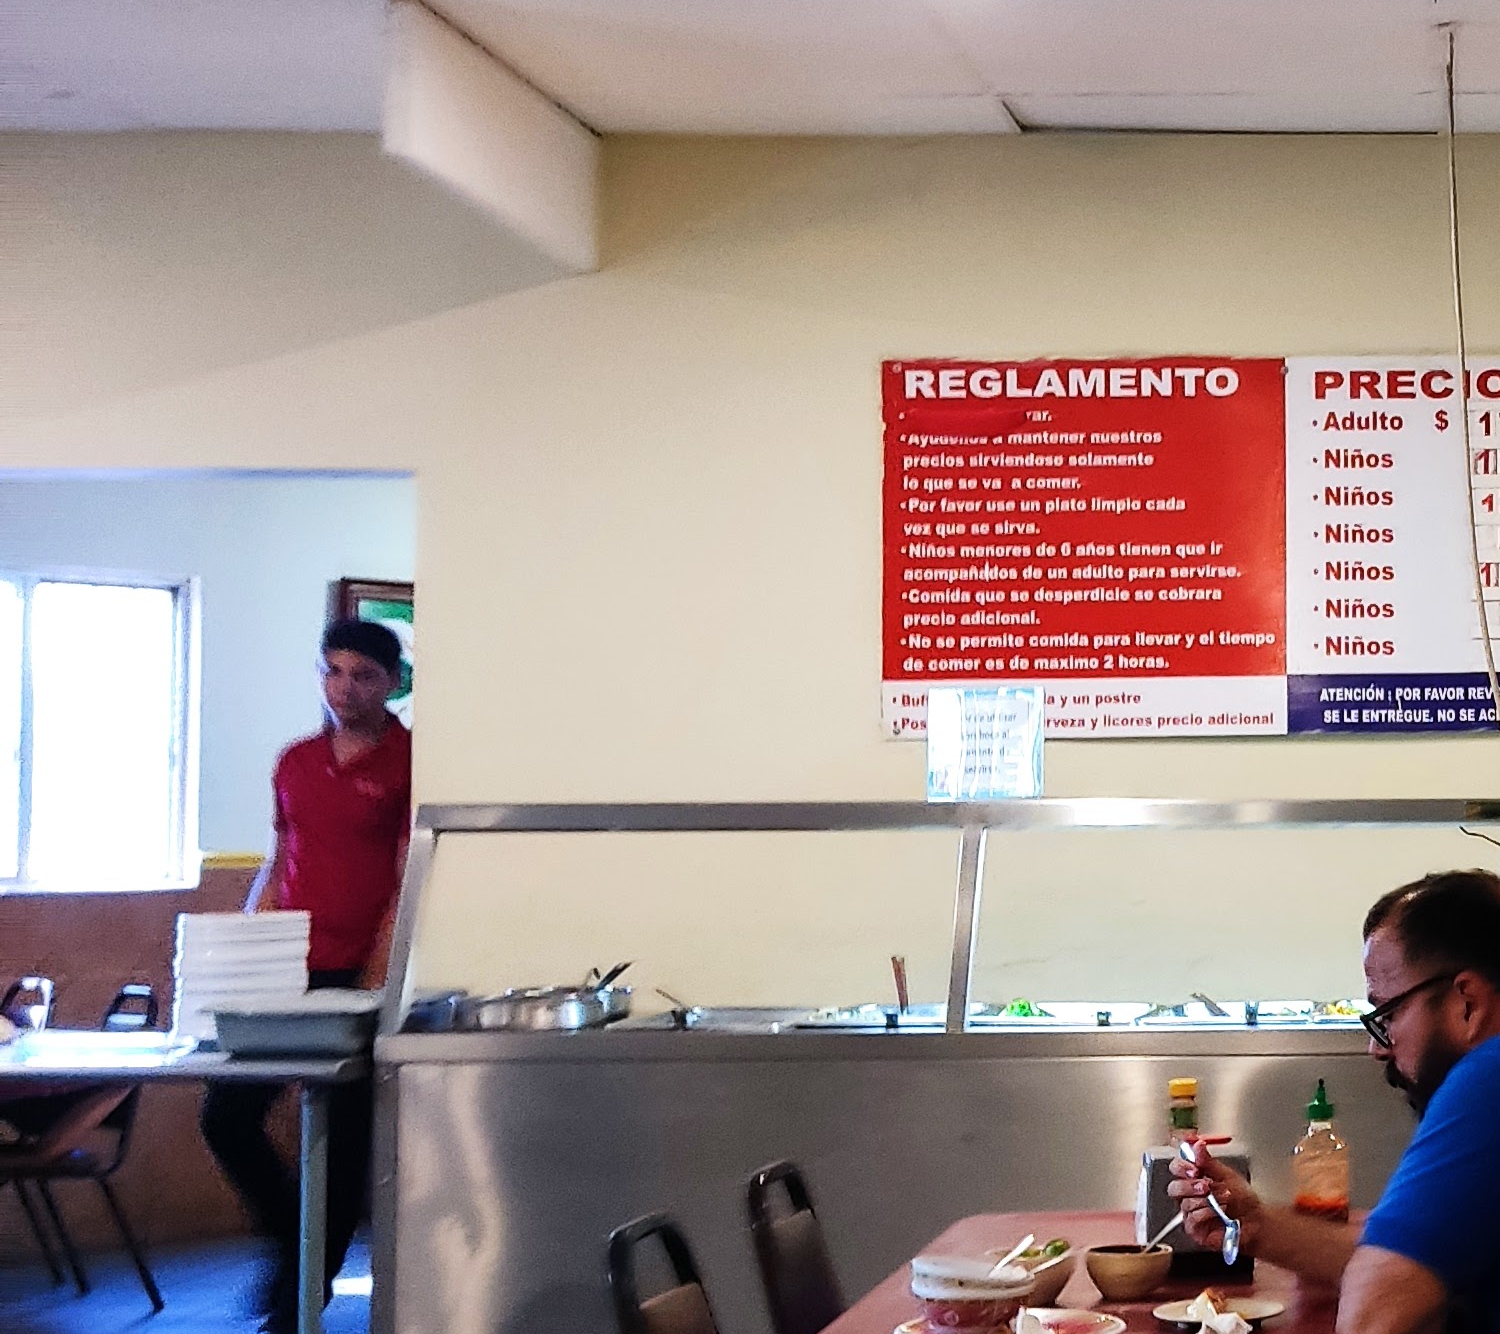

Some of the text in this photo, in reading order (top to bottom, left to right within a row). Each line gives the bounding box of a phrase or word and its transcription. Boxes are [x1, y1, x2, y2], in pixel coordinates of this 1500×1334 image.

[905, 368, 1238, 398] REGLAMENTO
[1324, 411, 1403, 431] Adulto
[1435, 410, 1448, 432] $
[1008, 431, 1085, 444] mantener
[1091, 431, 1161, 443] nuestros
[904, 453, 1153, 470] precios sirviendose solamente
[1325, 449, 1393, 468] Niños
[904, 475, 1081, 493] lo que se va a comer.
[1325, 486, 1393, 506] Niños
[909, 497, 1185, 514] Por favor use un plato limpio cada
[904, 520, 1040, 538] vez que se sirva.
[1326, 524, 1393, 543] Niños
[909, 543, 955, 558] Niños
[960, 546, 1030, 557] menores
[1036, 543, 1056, 556] de
[1076, 542, 1114, 556] años
[1120, 542, 1171, 555] tienen
[1176, 544, 1205, 558] que
[1211, 541, 1223, 555] ir
[1023, 565, 1042, 579] de
[1048, 568, 1067, 579] un
[1073, 565, 1123, 578] adulto
[1129, 568, 1165, 581] para
[1171, 565, 1241, 578] servirse.
[1326, 561, 1394, 580] Niños
[909, 588, 970, 603] Comida
[976, 591, 1005, 605] que
[1011, 591, 1029, 602] se
[1135, 590, 1153, 600] se
[1159, 587, 1221, 600] cobrara
[1326, 599, 1394, 618] Niños
[904, 610, 1040, 628] precio adicional.
[909, 631, 1275, 650] No se permite comida para llevar y el tiempo
[1326, 636, 1394, 655] Niños
[903, 654, 1169, 671] de comer es de maximo 2 horas.
[1061, 696, 1067, 707] y
[1073, 696, 1089, 704] un
[1096, 692, 1140, 706] postre
[1320, 683, 1384, 701] ATENCIÓN
[1395, 686, 1421, 701] POR
[1425, 688, 1464, 700] FAVOR
[1091, 718, 1097, 730] y
[1104, 715, 1152, 726] licores
[1158, 715, 1202, 728] precio
[1209, 714, 1273, 724] adicional
[1324, 710, 1340, 723] SE
[1344, 709, 1358, 722] LE
[1362, 709, 1433, 724] ENTREGUE.
[1438, 709, 1455, 722] NO
[1460, 709, 1475, 721] SE
